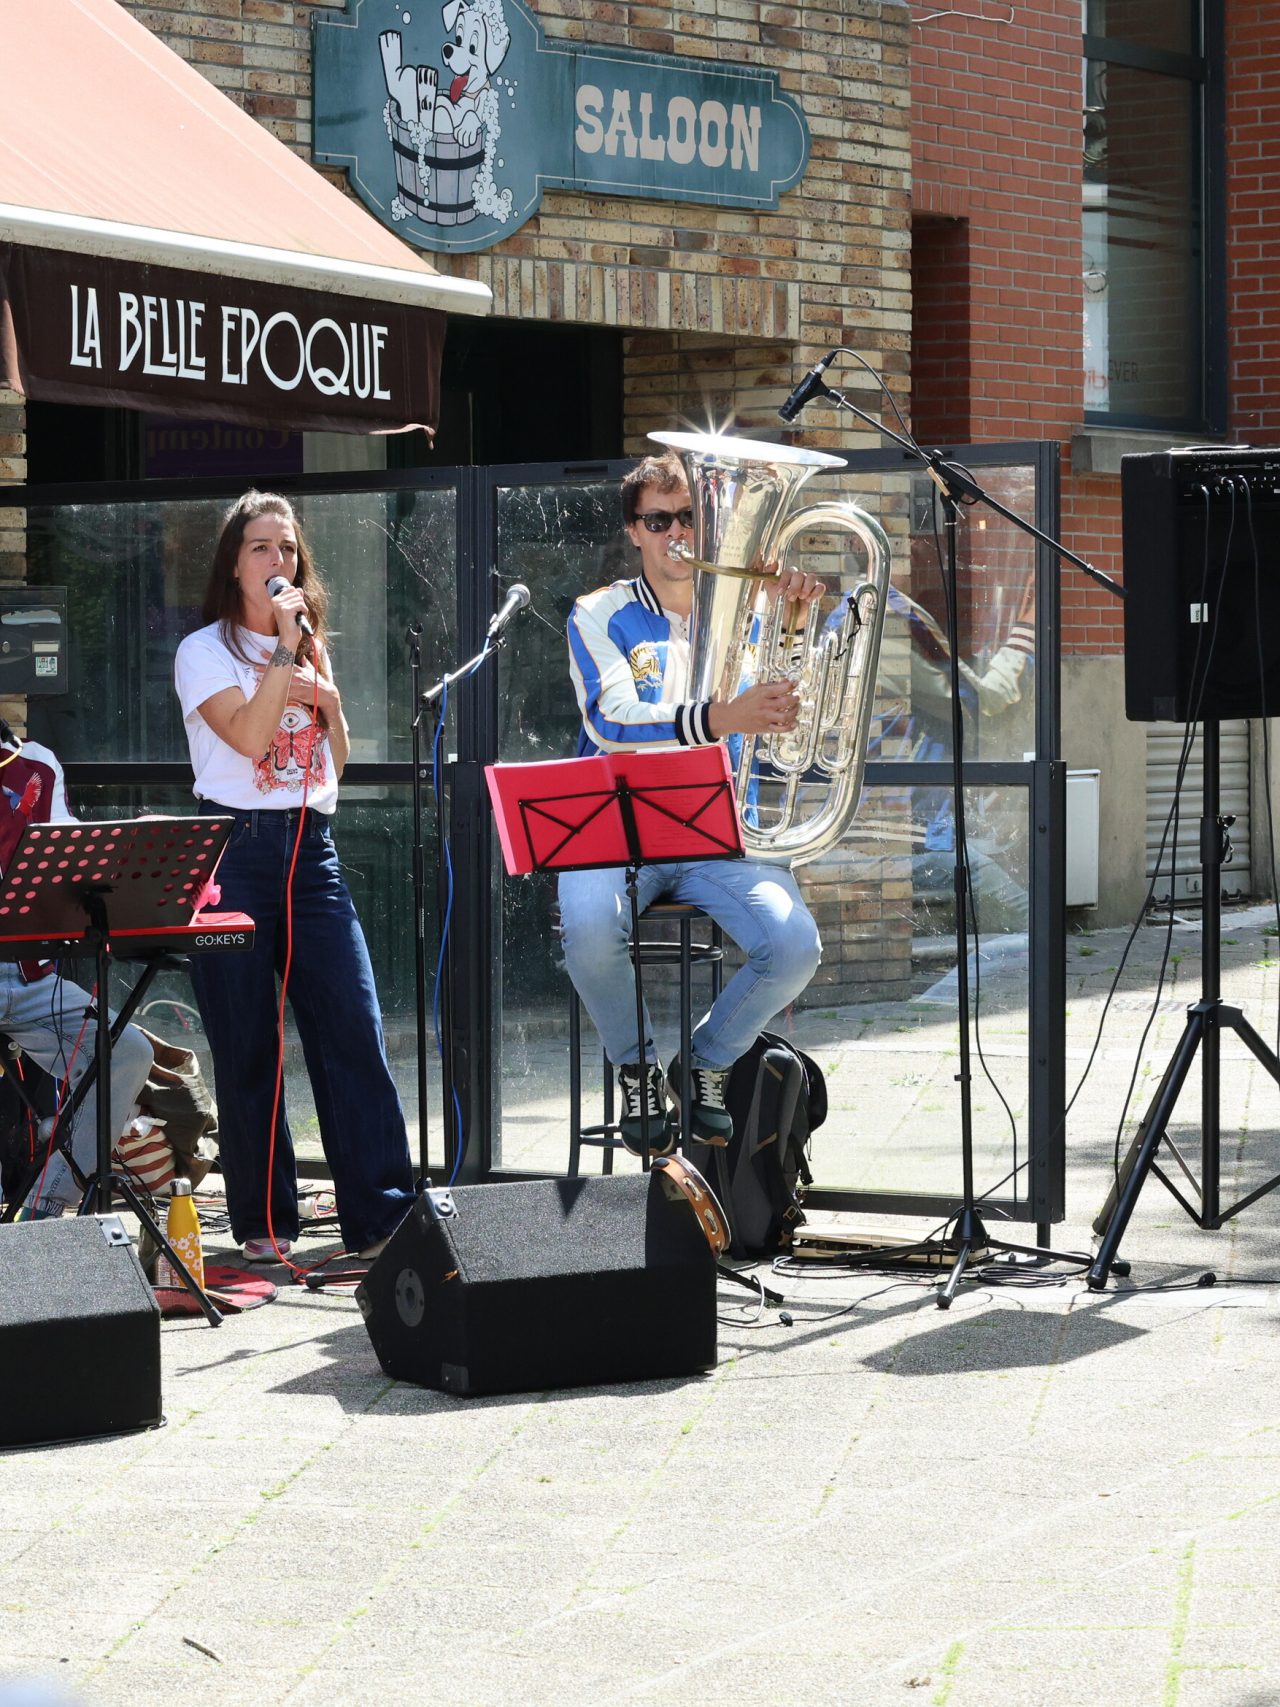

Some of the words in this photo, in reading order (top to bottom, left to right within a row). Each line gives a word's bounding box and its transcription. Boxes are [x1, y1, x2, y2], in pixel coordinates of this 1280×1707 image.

[575, 84, 762, 173] SALOON
[70, 285, 102, 369] LA
[118, 291, 206, 380] BELLE
[220, 305, 391, 400] EPOQUE
[195, 933, 245, 946] GO:KEYS
